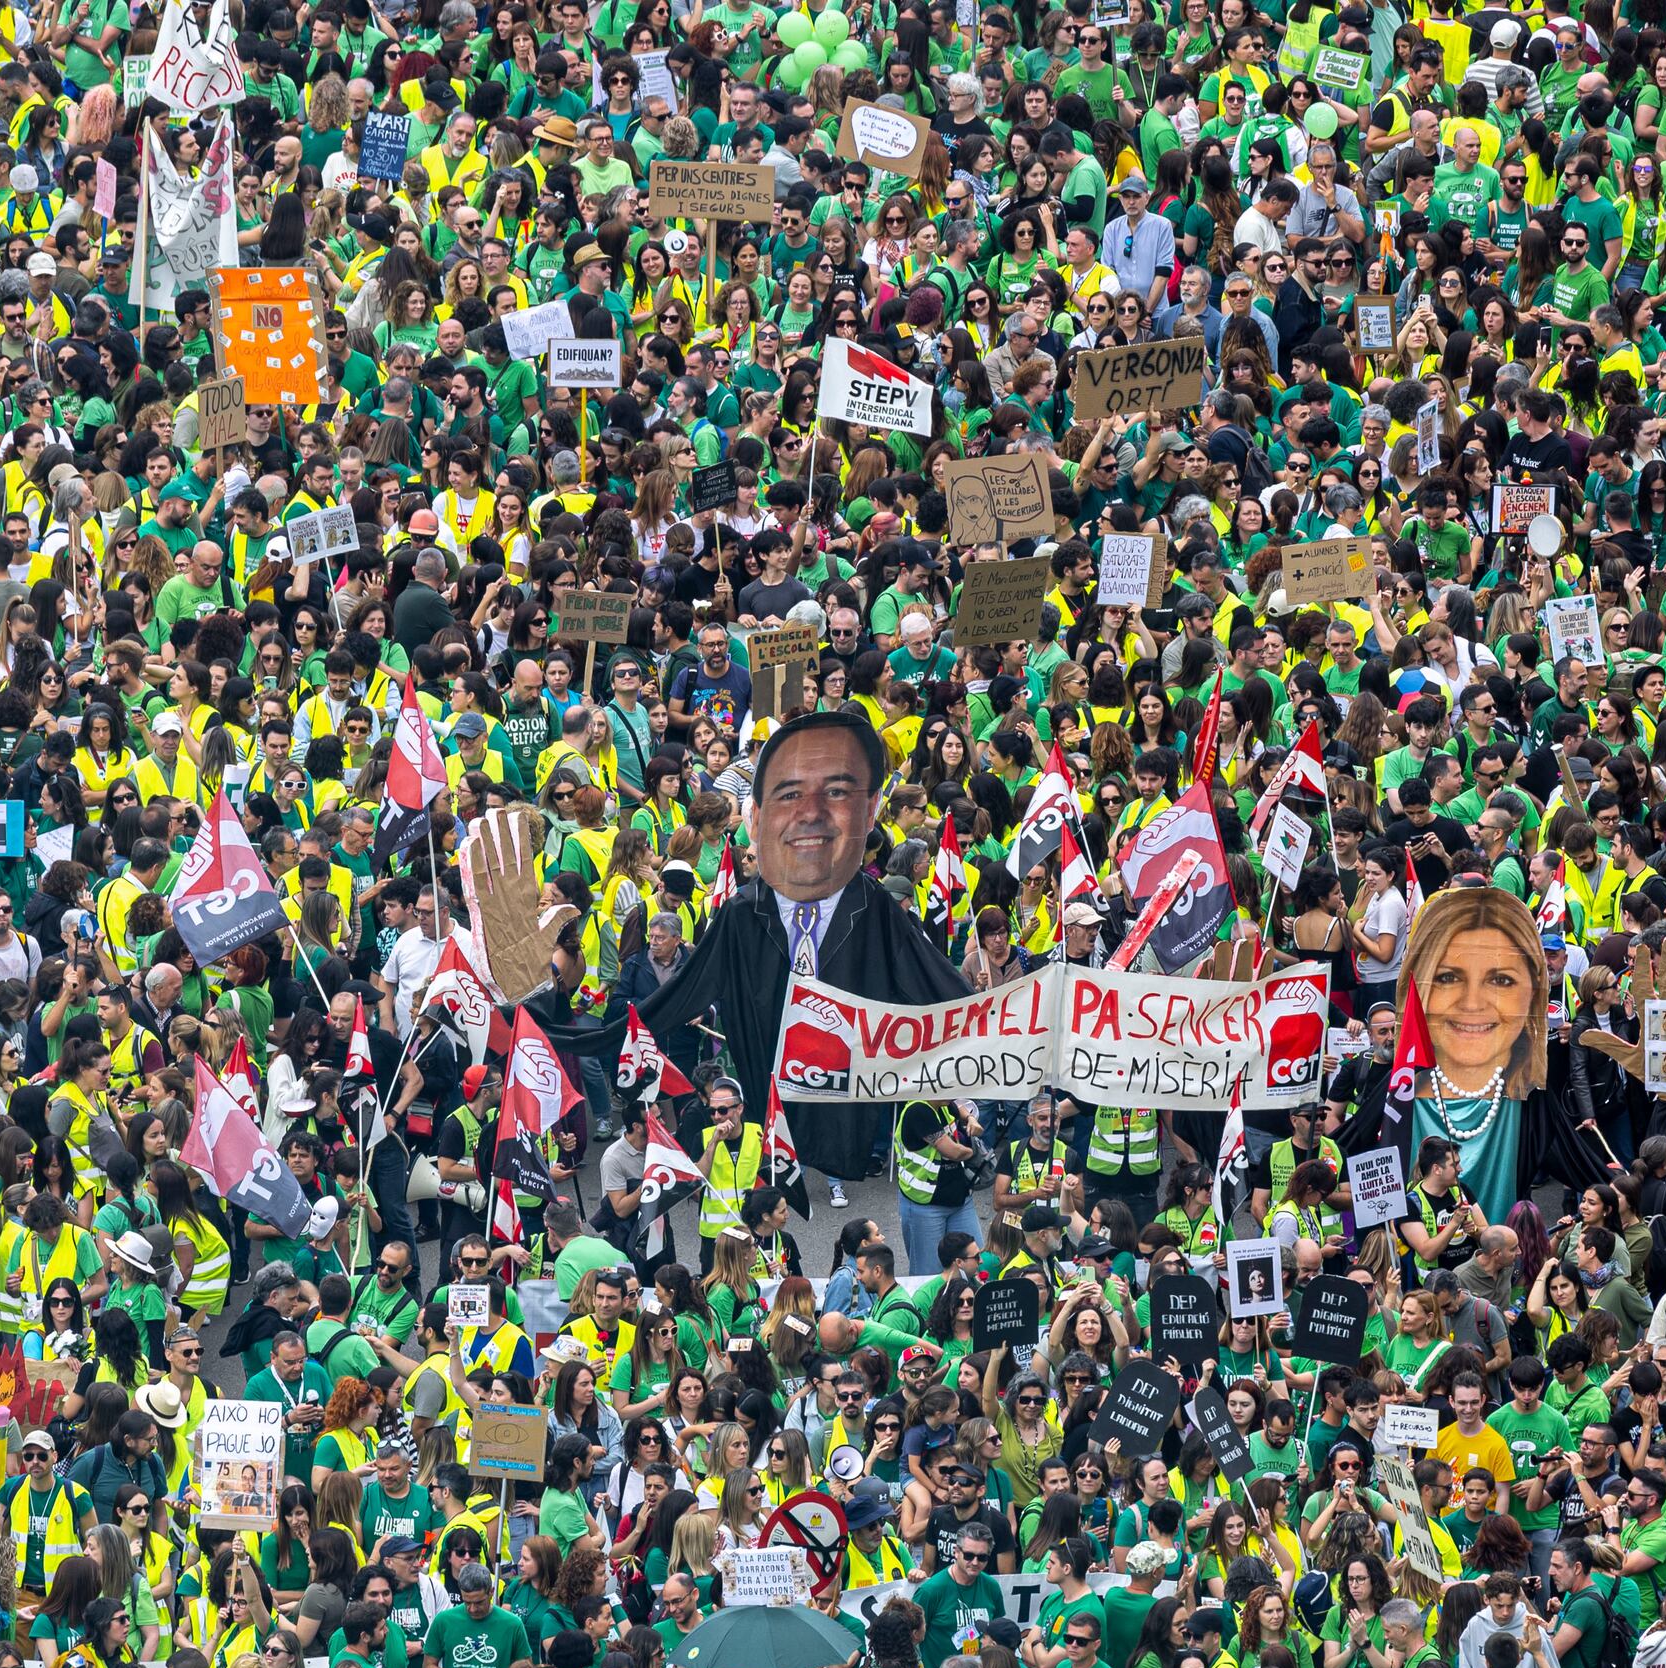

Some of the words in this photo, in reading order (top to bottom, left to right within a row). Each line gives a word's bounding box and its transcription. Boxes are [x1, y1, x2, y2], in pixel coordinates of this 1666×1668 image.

[656, 167, 679, 182] PER
[681, 168, 700, 185] UNS
[703, 169, 757, 186] CENTRES
[656, 186, 726, 200] EDUCATIUS
[731, 190, 771, 204] DIGNES
[690, 203, 745, 215] SEGURS
[557, 348, 613, 363] EDIFIQUAN?
[1085, 345, 1203, 388] VERGONYA
[201, 380, 243, 417] TODO
[849, 379, 918, 408] STEPV
[1106, 380, 1173, 411] ORTÍ
[847, 399, 915, 420] INTERSINDICAL
[856, 410, 913, 428] VALENCIANA
[203, 414, 238, 445] MAL
[785, 1058, 848, 1088] CGT
[206, 1403, 247, 1423] AIXÒ
[259, 1407, 279, 1424] HO
[206, 1432, 251, 1453] PAGUE
